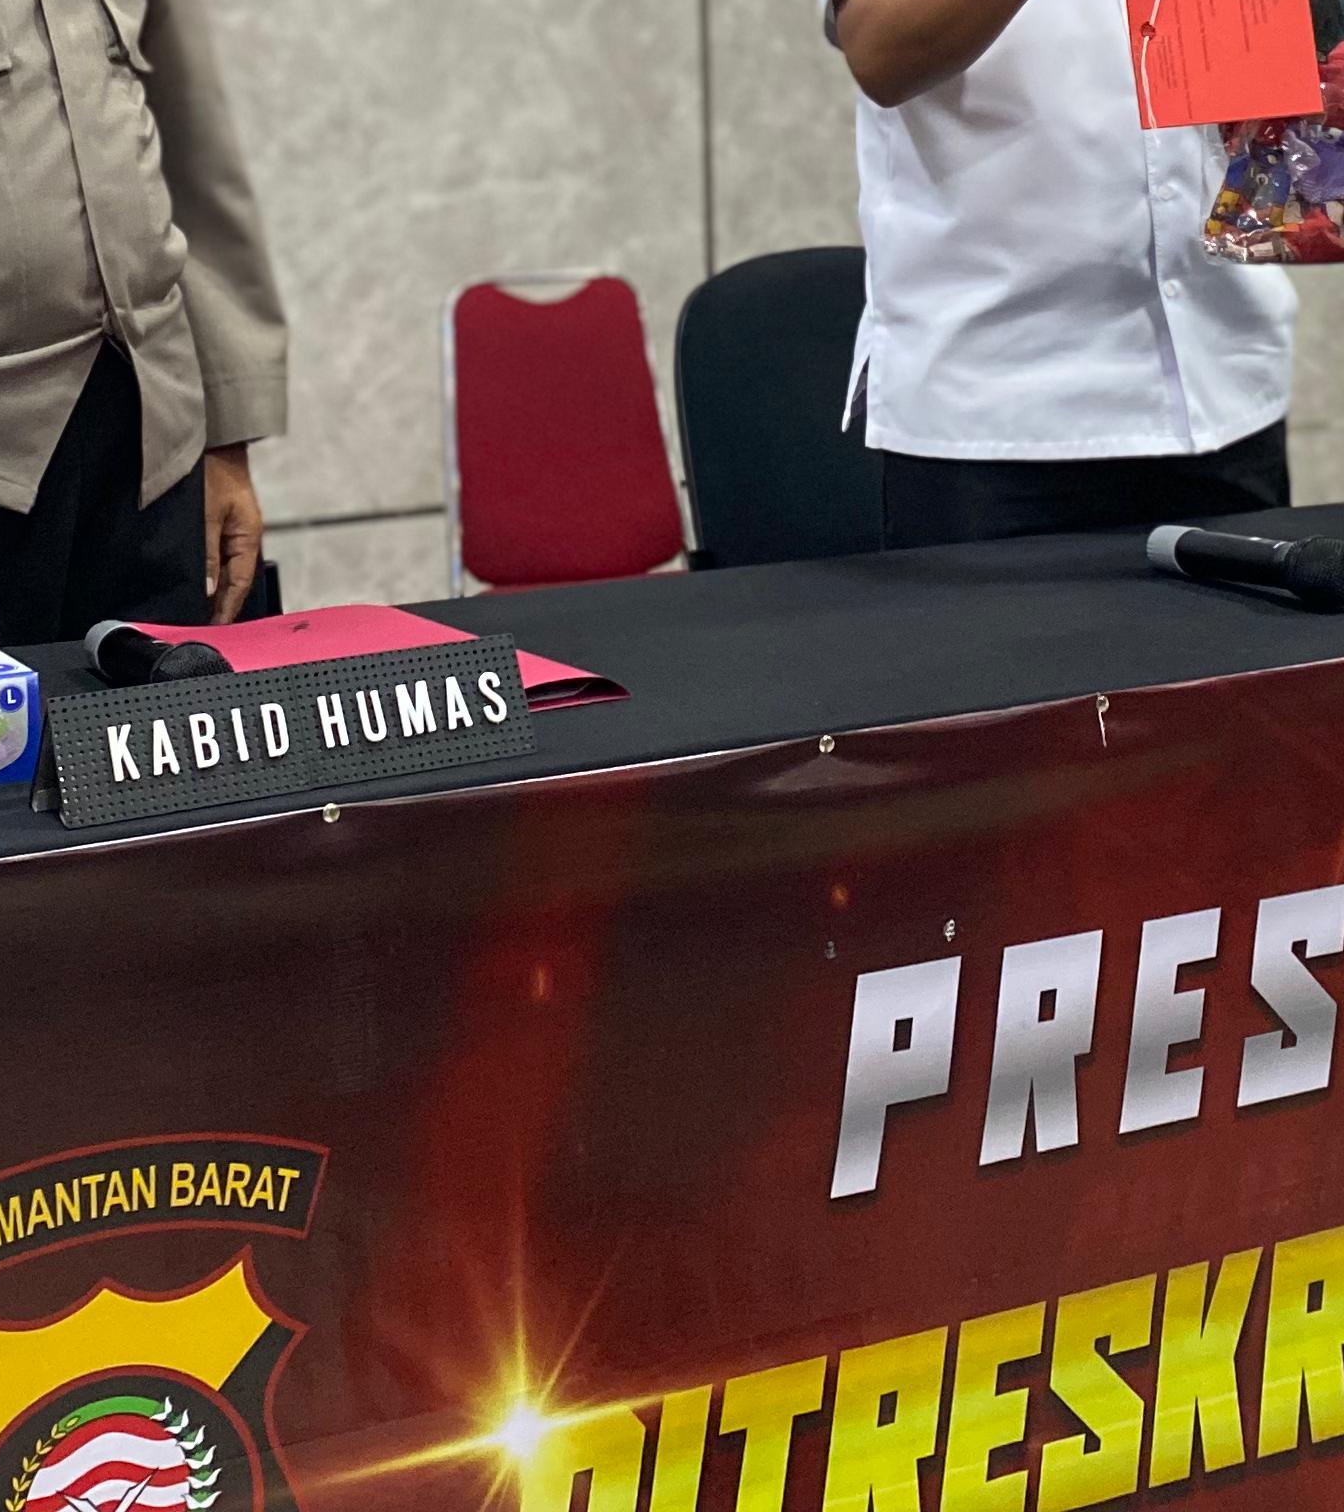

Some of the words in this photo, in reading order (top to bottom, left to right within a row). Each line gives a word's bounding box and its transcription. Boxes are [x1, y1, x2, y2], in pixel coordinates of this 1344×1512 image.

[6, 689, 17, 705] L
[106, 701, 291, 782] KABID
[316, 670, 509, 749] HUMAS
[169, 1161, 301, 1212] BARAT
